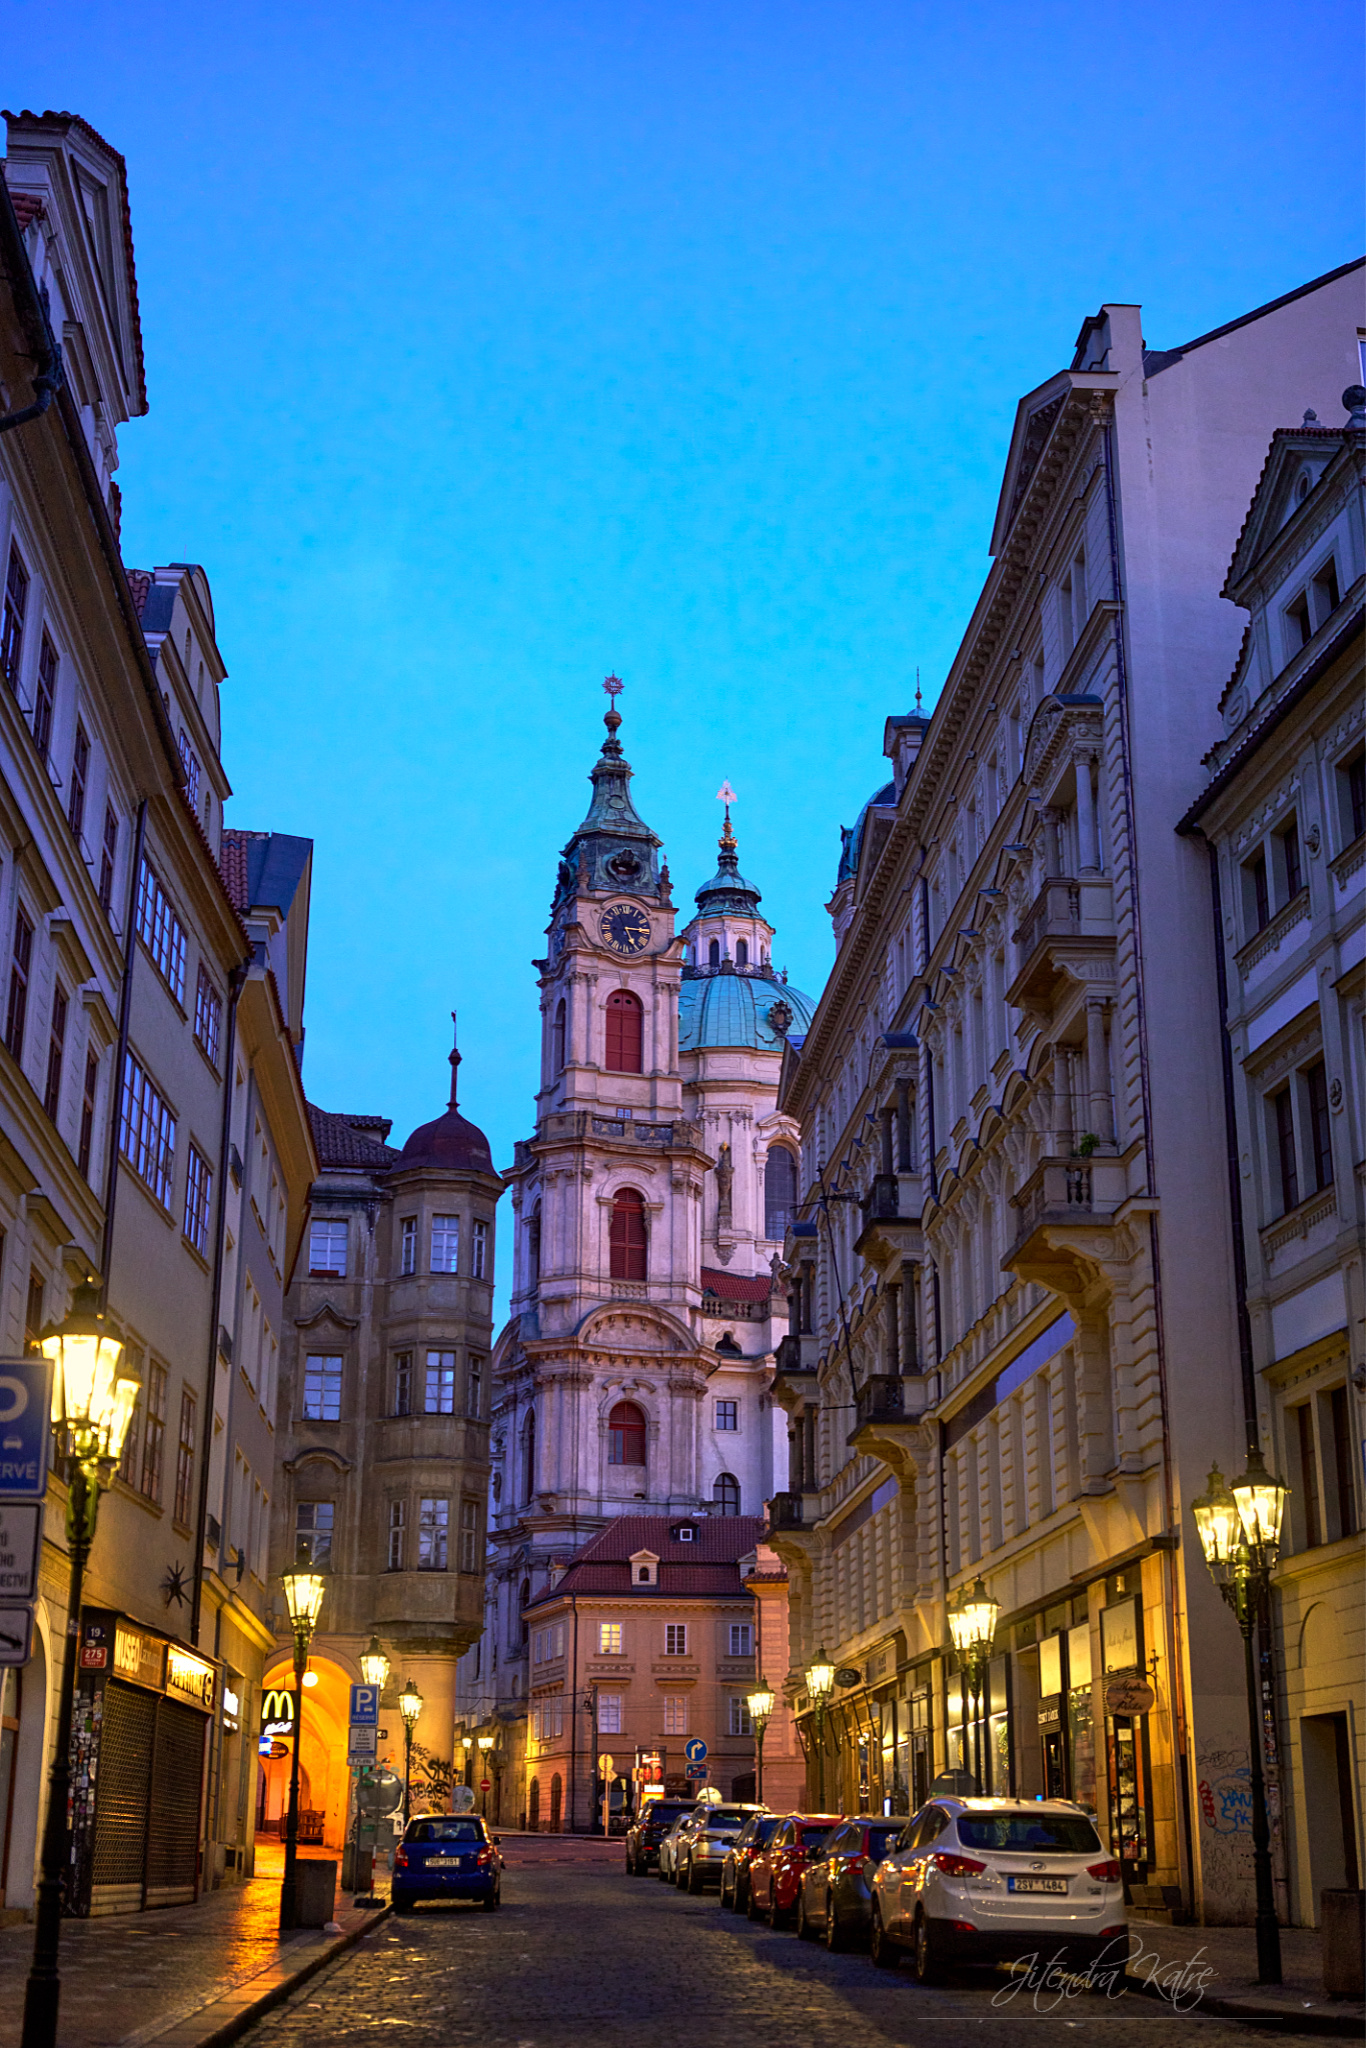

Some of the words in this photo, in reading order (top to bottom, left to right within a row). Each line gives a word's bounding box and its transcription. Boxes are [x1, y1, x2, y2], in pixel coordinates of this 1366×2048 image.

[84, 1649, 102, 1659] 275
[355, 1689, 373, 1713] P
[1016, 1880, 1033, 1890] 2SV
[1042, 1881, 1063, 1890] 1484
